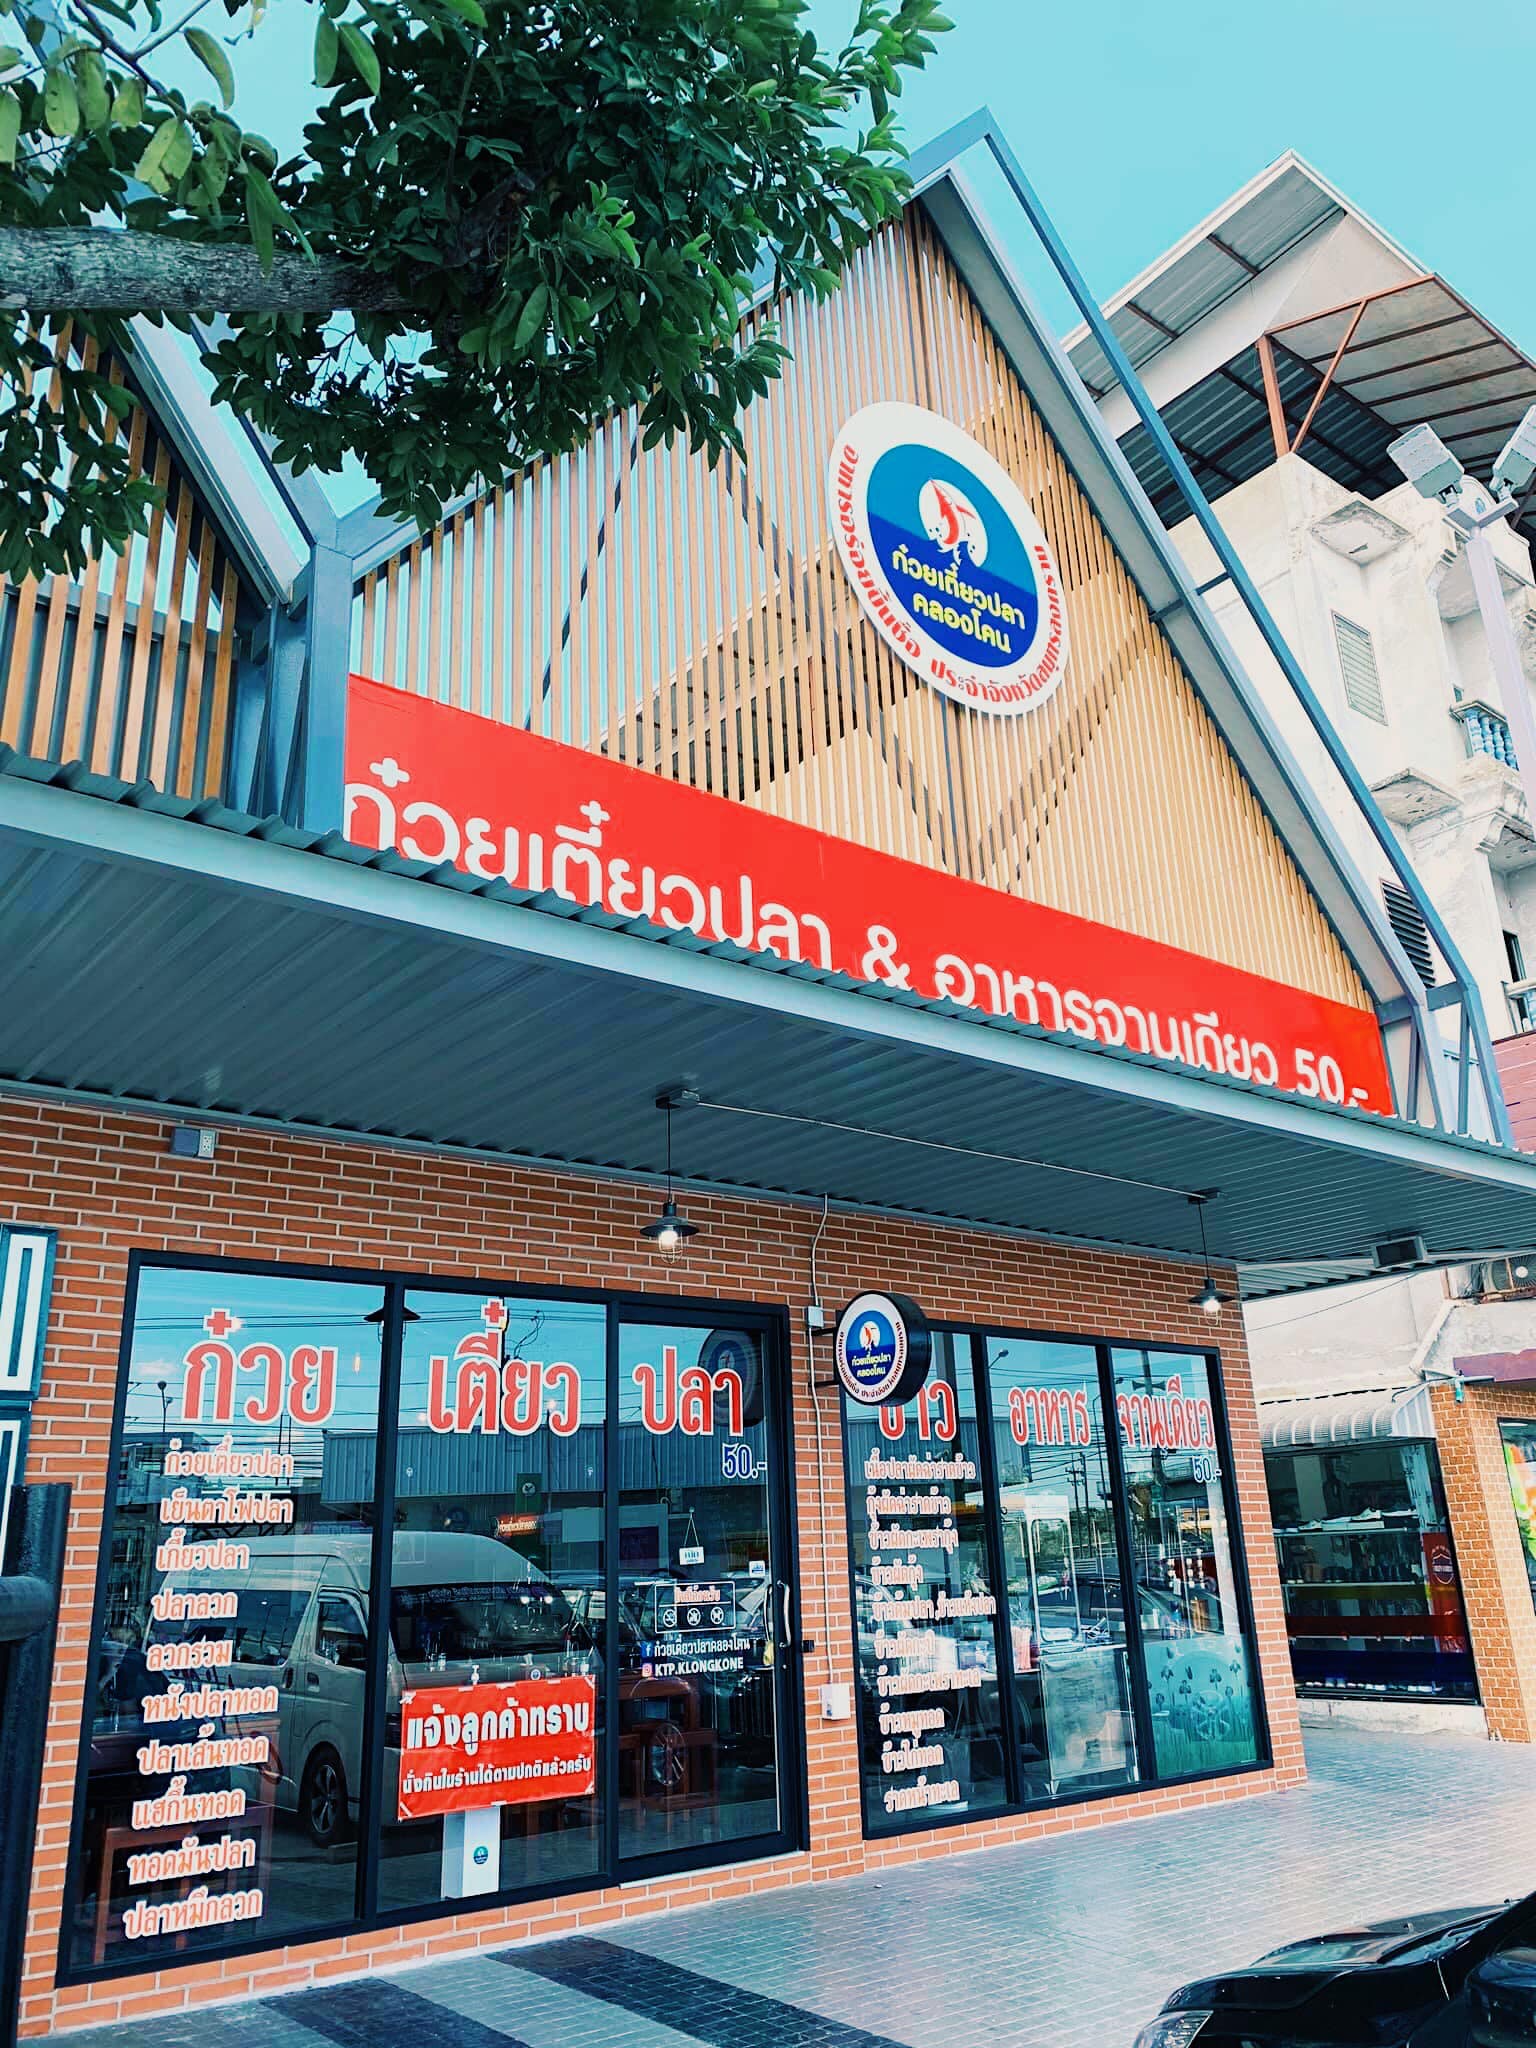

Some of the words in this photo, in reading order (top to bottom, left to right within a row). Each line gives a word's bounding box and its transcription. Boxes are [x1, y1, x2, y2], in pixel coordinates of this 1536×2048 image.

[891, 543, 1026, 630] ก๋วยเตี๋ยวปลา
[913, 592, 1012, 654] คลองโคน
[343, 757, 834, 973] ก๋วยเตี๋ยวปลา
[862, 924, 910, 991] &
[935, 954, 1279, 1087] อาหารจานเดียว
[181, 1307, 338, 1426] ก๋วย
[428, 1297, 582, 1436] เตี๋ยว
[632, 1344, 745, 1437] ปลา
[1009, 1384, 1091, 1446] อาหาร
[1116, 1374, 1217, 1450] จานเดียว
[164, 1433, 295, 1478] ก๋วยเตี๋ยวปลา
[722, 1442, 767, 1479] 50.-
[1193, 1456, 1223, 1484] 50.-
[160, 1486, 293, 1524] เย็นตาโฟปลา
[156, 1528, 250, 1571] เกี๊ยวปลา
[151, 1588, 238, 1621] ปลาลวก
[147, 1638, 234, 1671] ลวกรวม
[655, 1657, 744, 1677] KTP.KLONGKONE
[141, 1683, 279, 1724] หนังปลาทอด
[137, 1723, 270, 1775] ปลาเส้นทอด
[406, 1697, 590, 1757] แจ้งลูกค้าทราบ
[881, 1738, 944, 1773] ข้าวไก่ทอด
[127, 1835, 256, 1886] ทอดมันปลา
[122, 1885, 263, 1940] ปลาหมึกลวก
